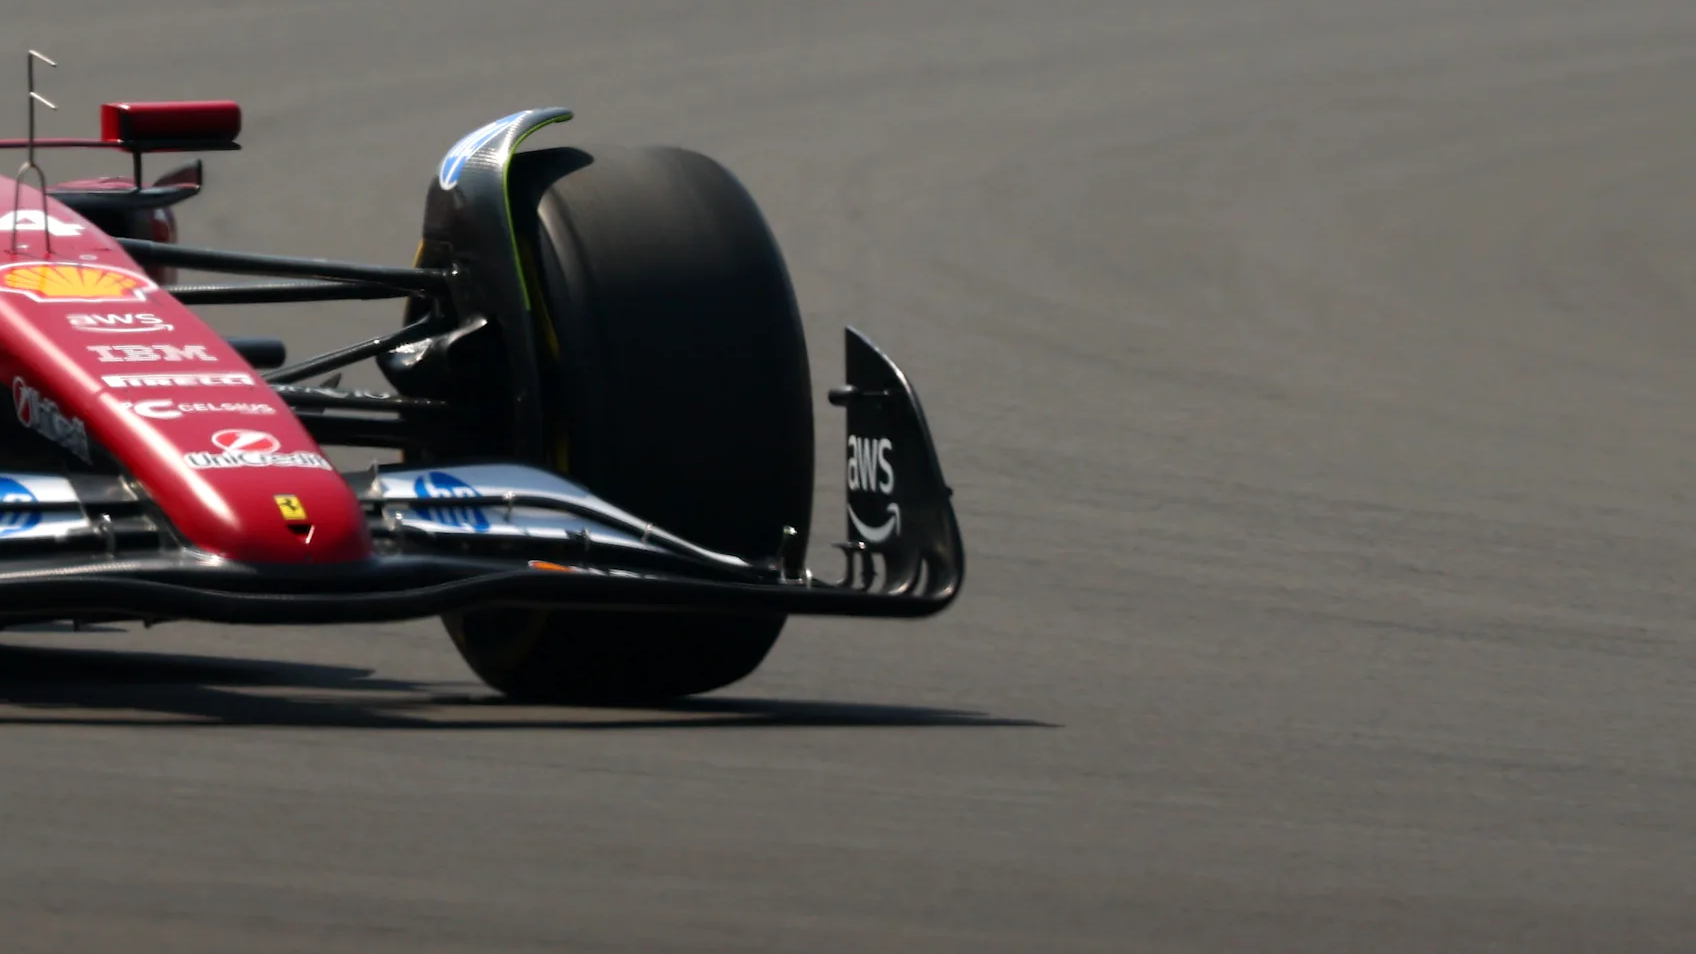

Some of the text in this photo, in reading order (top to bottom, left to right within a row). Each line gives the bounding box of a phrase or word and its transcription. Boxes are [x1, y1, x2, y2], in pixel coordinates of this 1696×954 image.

[66, 313, 164, 327] aws
[88, 344, 218, 362] IBM
[101, 373, 254, 388] PIRELLI
[184, 450, 333, 471] UniCredit
[847, 434, 895, 495] aws
